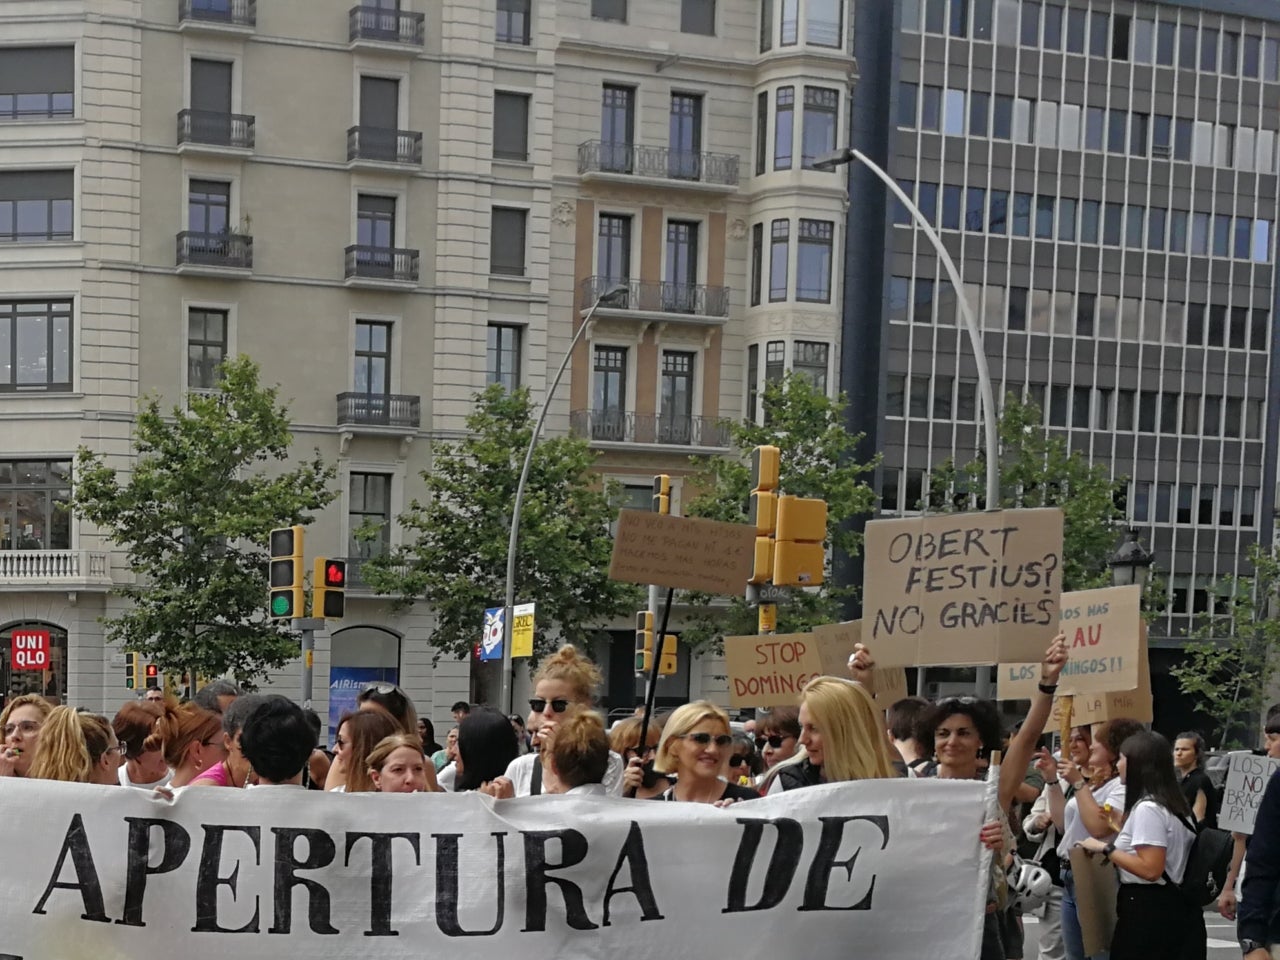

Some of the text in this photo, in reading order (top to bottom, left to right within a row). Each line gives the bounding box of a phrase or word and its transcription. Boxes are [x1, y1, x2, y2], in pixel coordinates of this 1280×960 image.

[889, 527, 1018, 563] OBERT
[873, 605, 924, 639] NO
[16, 635, 43, 649] UNI
[1064, 623, 1102, 648] AU
[16, 650, 45, 667] QLO
[755, 641, 806, 665] STOP
[1010, 665, 1035, 681] LOS
[1233, 756, 1263, 775] LOS
[1243, 775, 1263, 793] NO
[32, 814, 665, 937] APERTURA
[721, 815, 889, 913] DE
